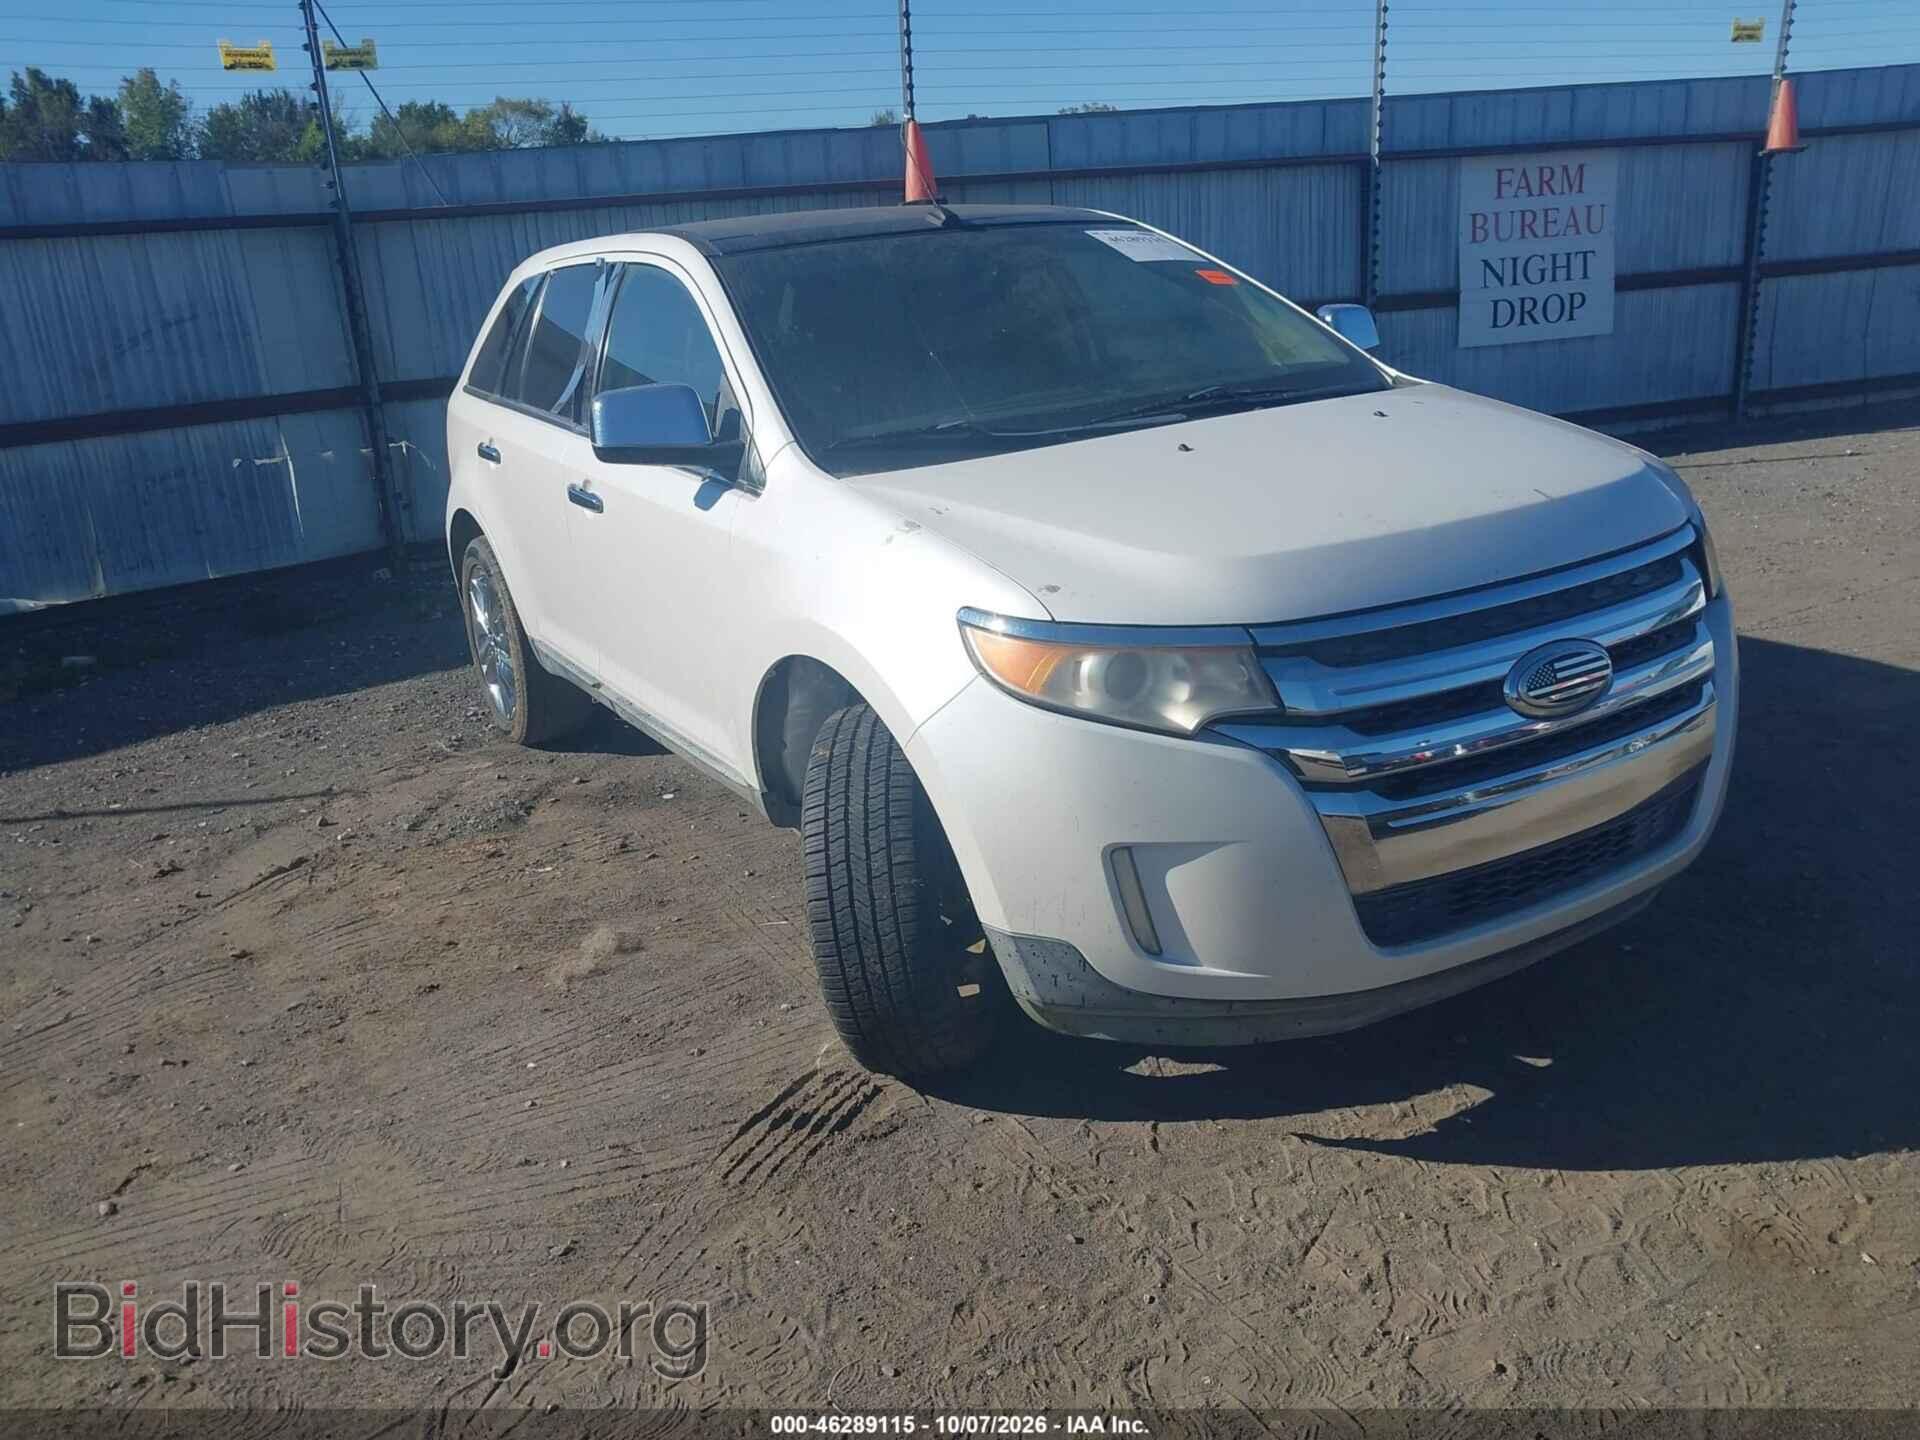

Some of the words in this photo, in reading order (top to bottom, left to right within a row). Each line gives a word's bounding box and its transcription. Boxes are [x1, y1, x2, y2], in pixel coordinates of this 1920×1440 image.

[1495, 163, 1586, 200] FARM
[1470, 204, 1607, 245] BUREAU
[1480, 250, 1596, 289] NIGHT
[1489, 291, 1587, 329] DROP
